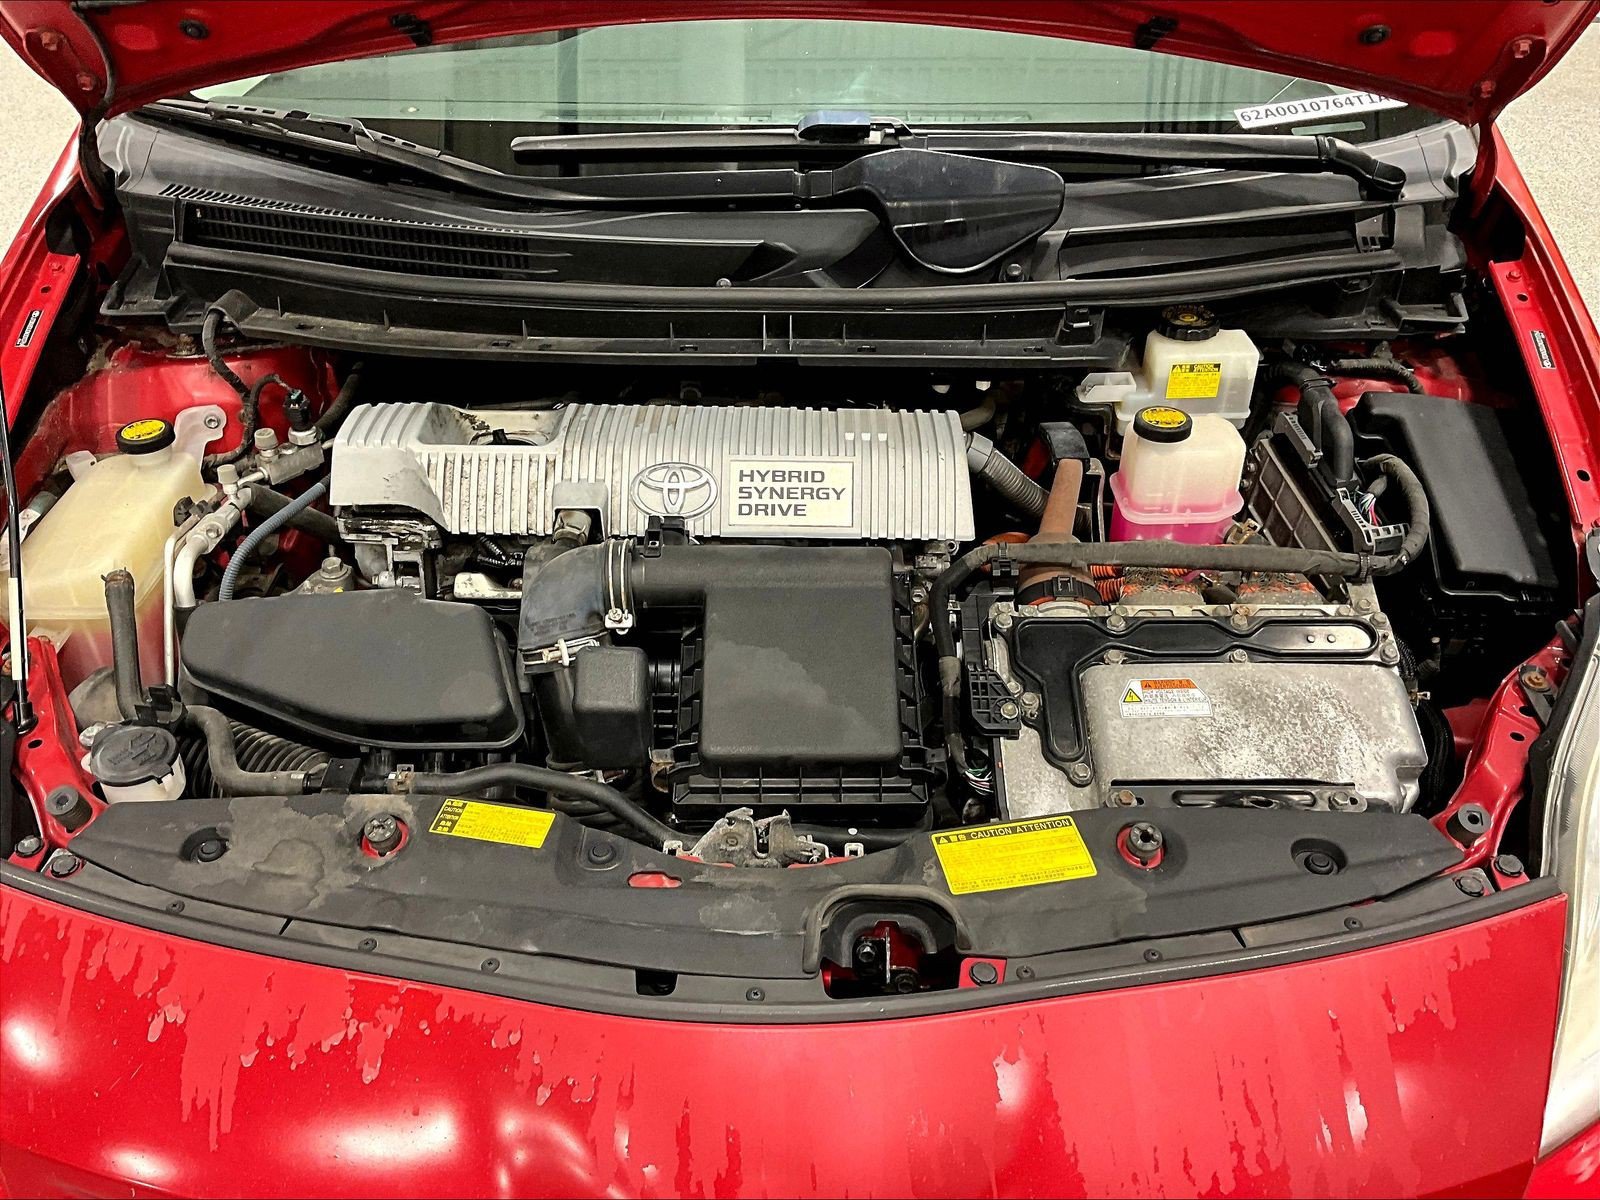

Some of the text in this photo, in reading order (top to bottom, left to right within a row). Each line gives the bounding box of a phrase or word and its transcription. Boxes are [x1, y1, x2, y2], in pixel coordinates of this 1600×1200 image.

[738, 470, 825, 483] HYBRID
[738, 486, 846, 500] SYNERGY
[738, 503, 807, 517] DRIVE
[970, 828, 1012, 840] CAUTION
[1016, 819, 1070, 834] ATTENTION
